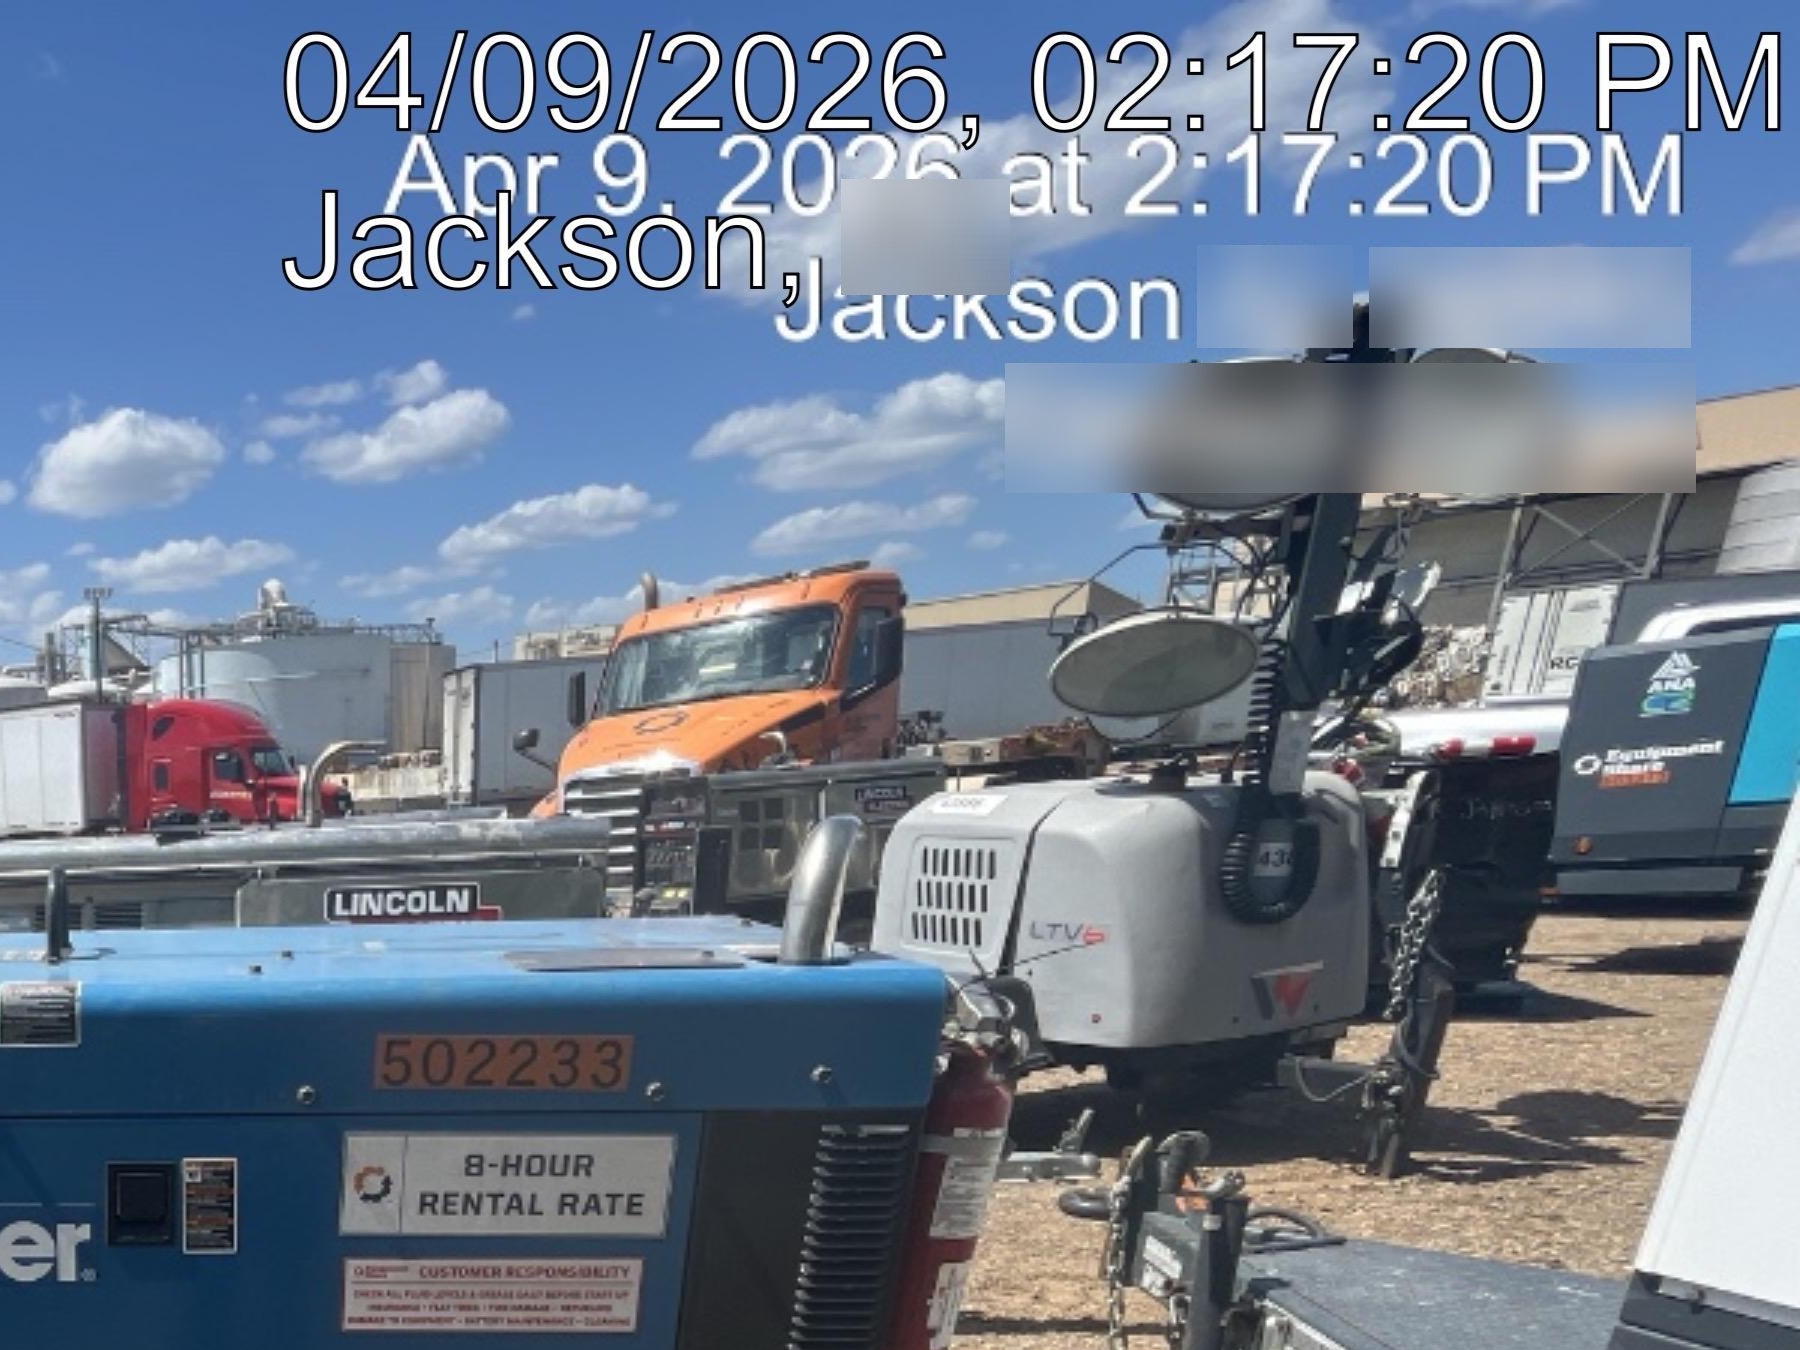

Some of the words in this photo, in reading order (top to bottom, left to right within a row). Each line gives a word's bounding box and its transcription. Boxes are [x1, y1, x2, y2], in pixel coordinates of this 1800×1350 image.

[335, 888, 470, 916] LINCOLN
[382, 1038, 624, 1088] 502233
[463, 1154, 594, 1178] 8-HOUR
[418, 1192, 544, 1216] RENTAL
[557, 1193, 645, 1216] RATE
[419, 1265, 502, 1279] CUSTOMER
[505, 1265, 630, 1279] RESPONSIBILITY
